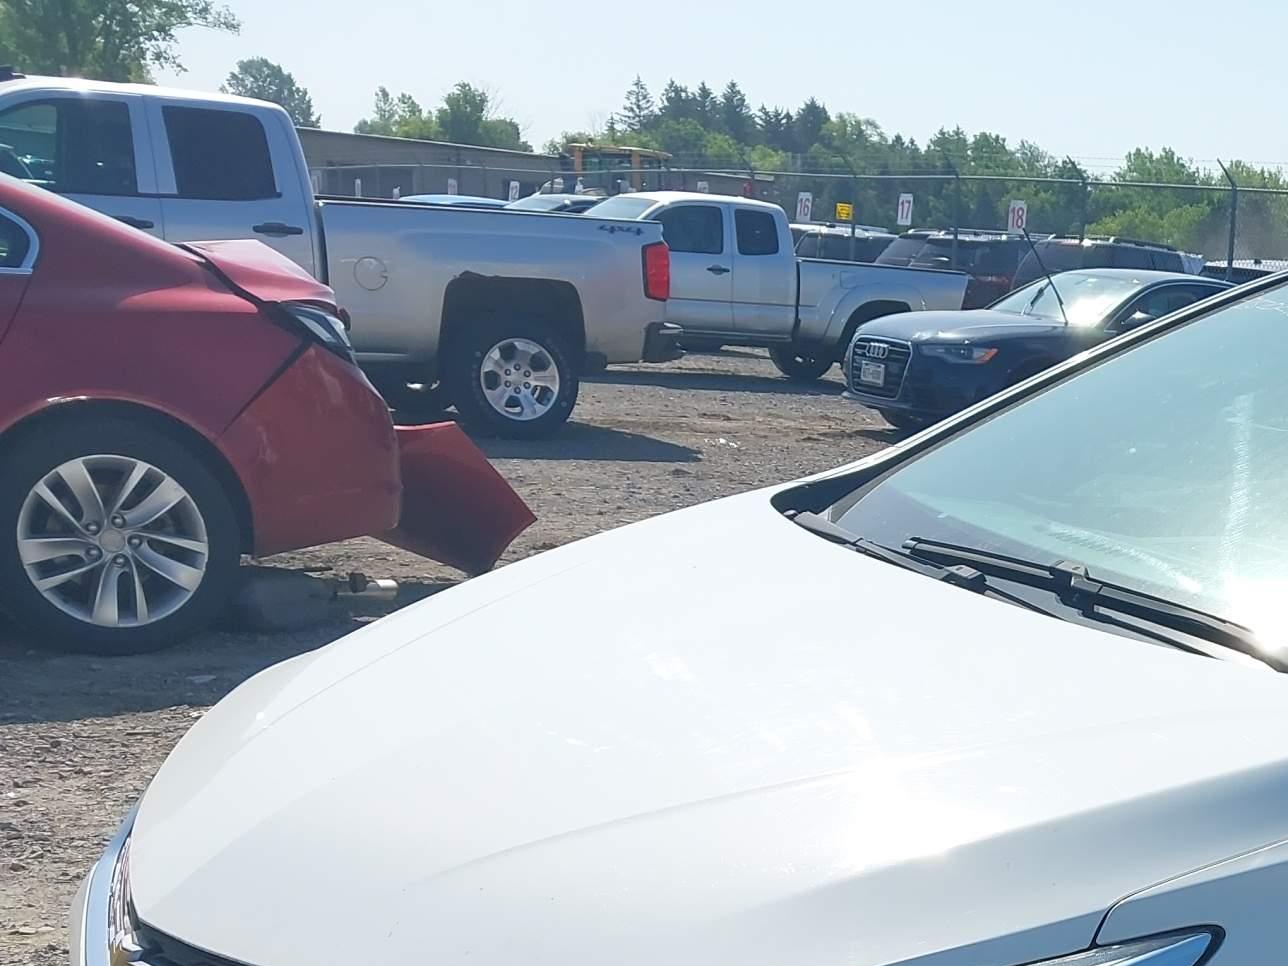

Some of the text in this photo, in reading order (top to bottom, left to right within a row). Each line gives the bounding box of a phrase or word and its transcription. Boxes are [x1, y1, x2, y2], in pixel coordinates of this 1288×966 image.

[799, 198, 810, 211] 16
[900, 201, 911, 220] 17
[1010, 207, 1025, 229] 18
